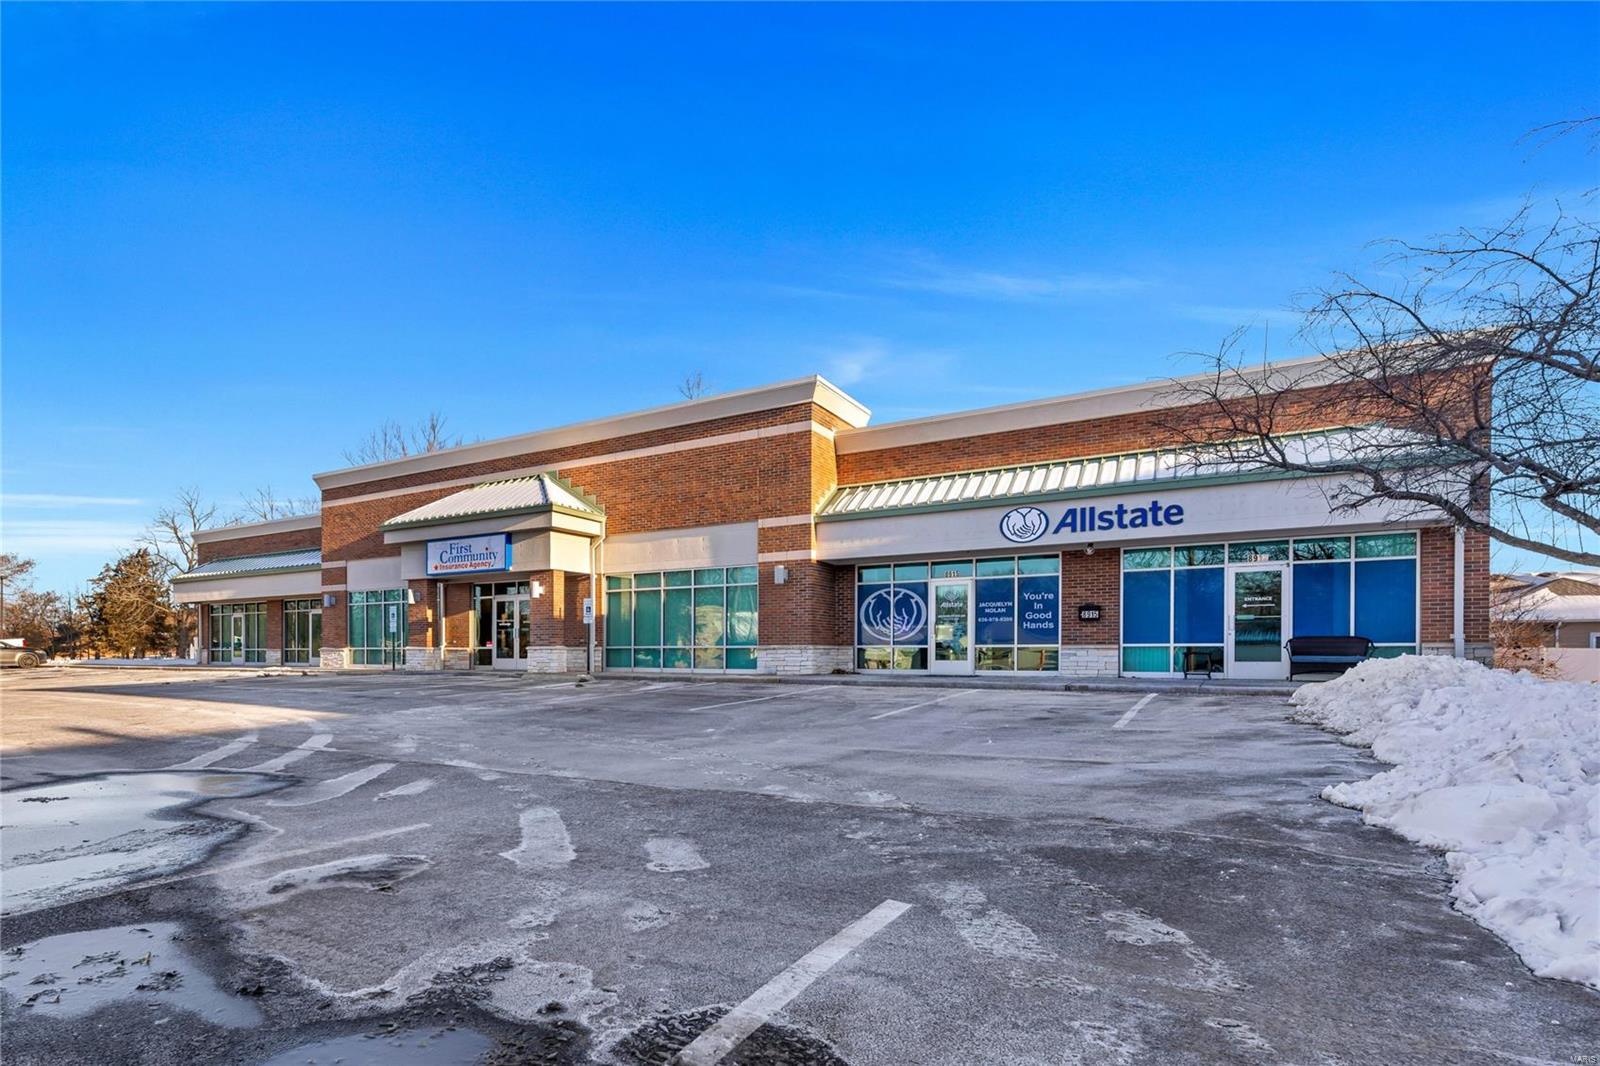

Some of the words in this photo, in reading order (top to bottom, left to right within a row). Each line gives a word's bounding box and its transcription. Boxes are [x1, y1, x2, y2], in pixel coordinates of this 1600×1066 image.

[1052, 500, 1184, 535] Allstate
[449, 543, 472, 555] First
[440, 550, 498, 567] Community
[439, 562, 468, 570] Insurance
[469, 560, 491, 569] Agency
[1023, 592, 1054, 600] You're
[1025, 611, 1052, 619] Good
[1023, 621, 1054, 629] Hands
